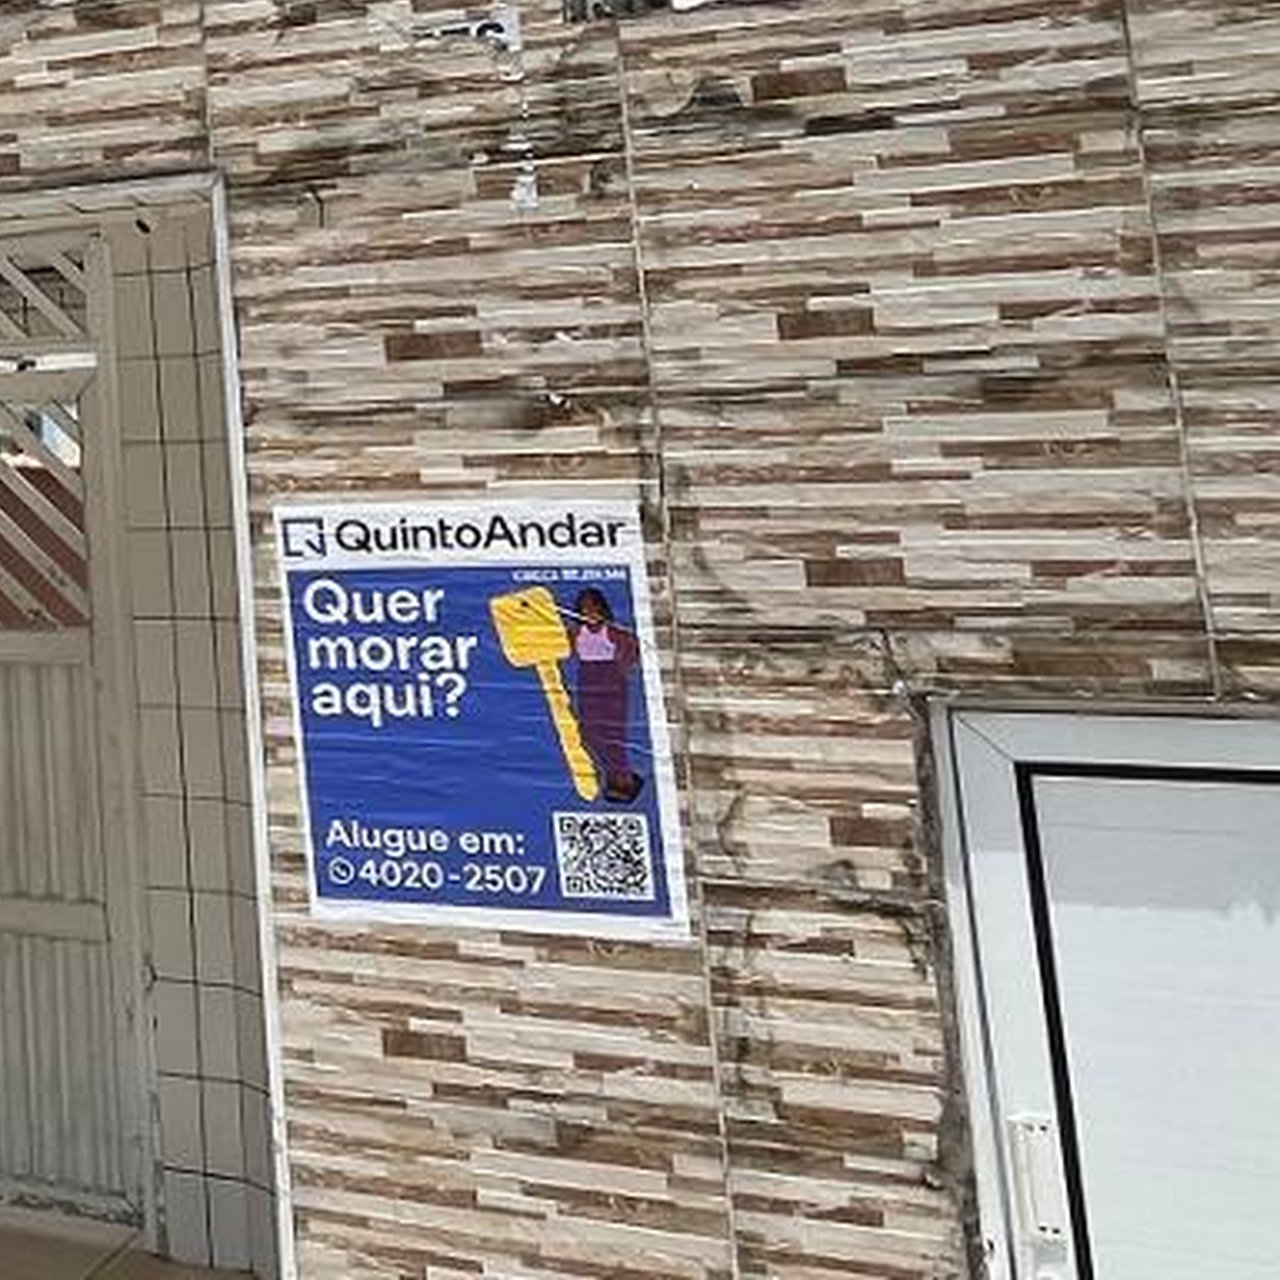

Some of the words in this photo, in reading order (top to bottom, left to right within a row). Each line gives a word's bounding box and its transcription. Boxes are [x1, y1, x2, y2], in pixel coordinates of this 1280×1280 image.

[334, 514, 627, 553] QuintoAndar
[302, 579, 445, 623] Quer
[307, 634, 478, 672] morar
[311, 673, 467, 727] aqui?
[325, 819, 449, 856] Alugue
[459, 832, 526, 856] em:
